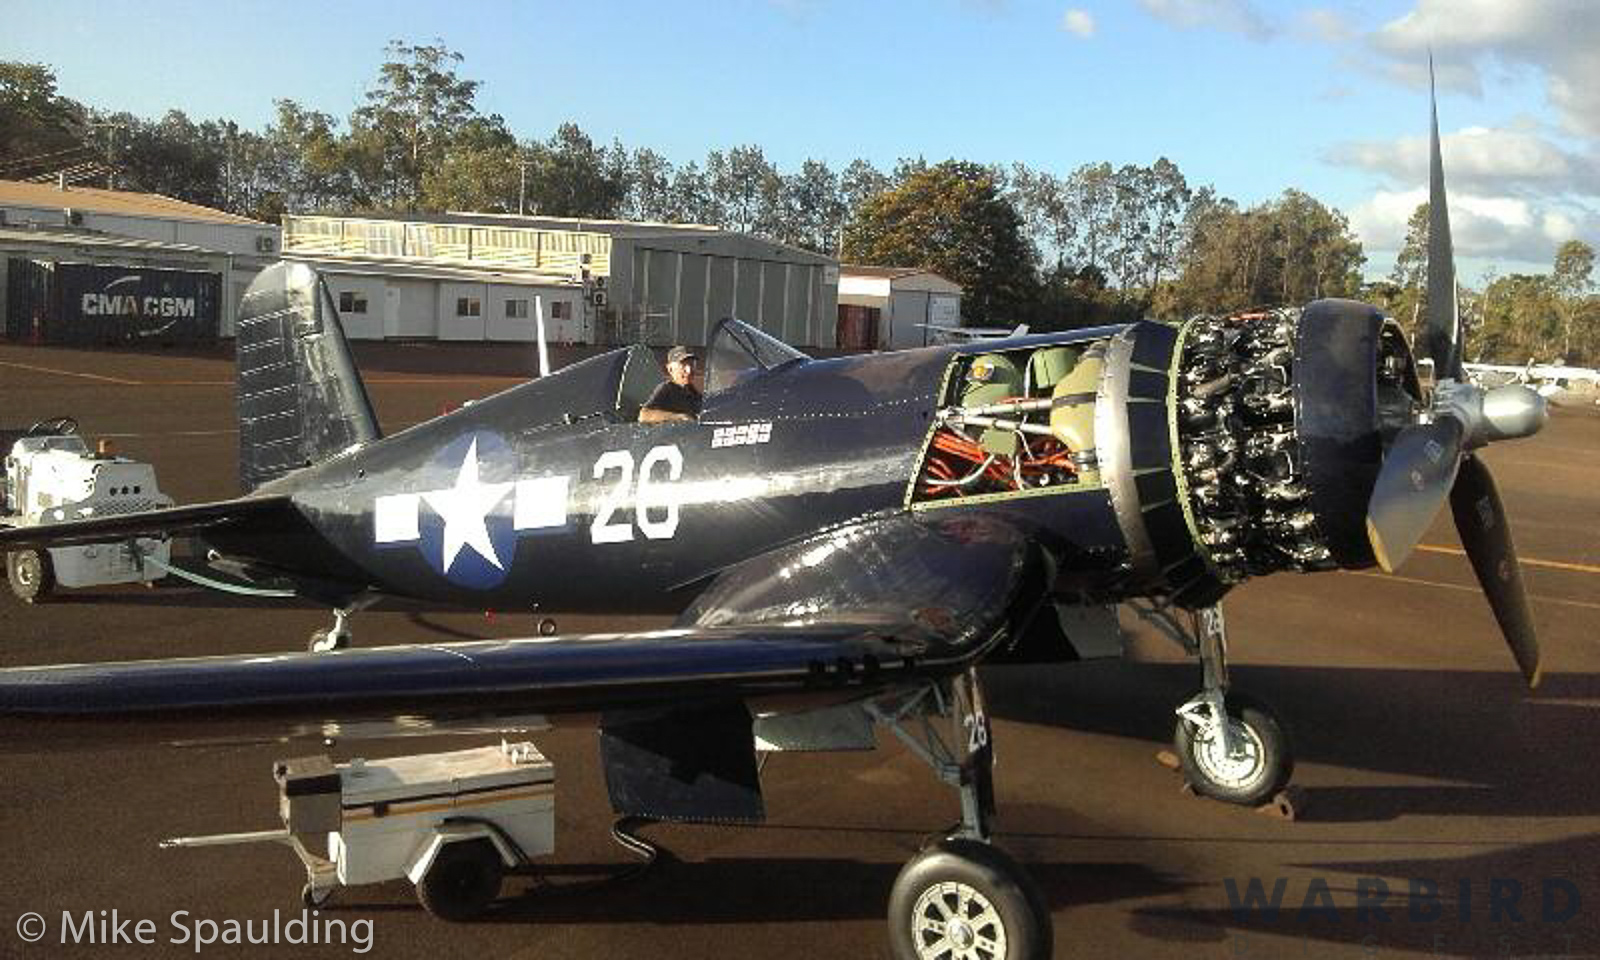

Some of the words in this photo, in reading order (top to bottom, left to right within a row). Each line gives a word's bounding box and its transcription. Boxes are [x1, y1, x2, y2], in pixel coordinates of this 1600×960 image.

[82, 293, 138, 315] CMA
[143, 296, 195, 317] CGM
[590, 444, 684, 545] 26
